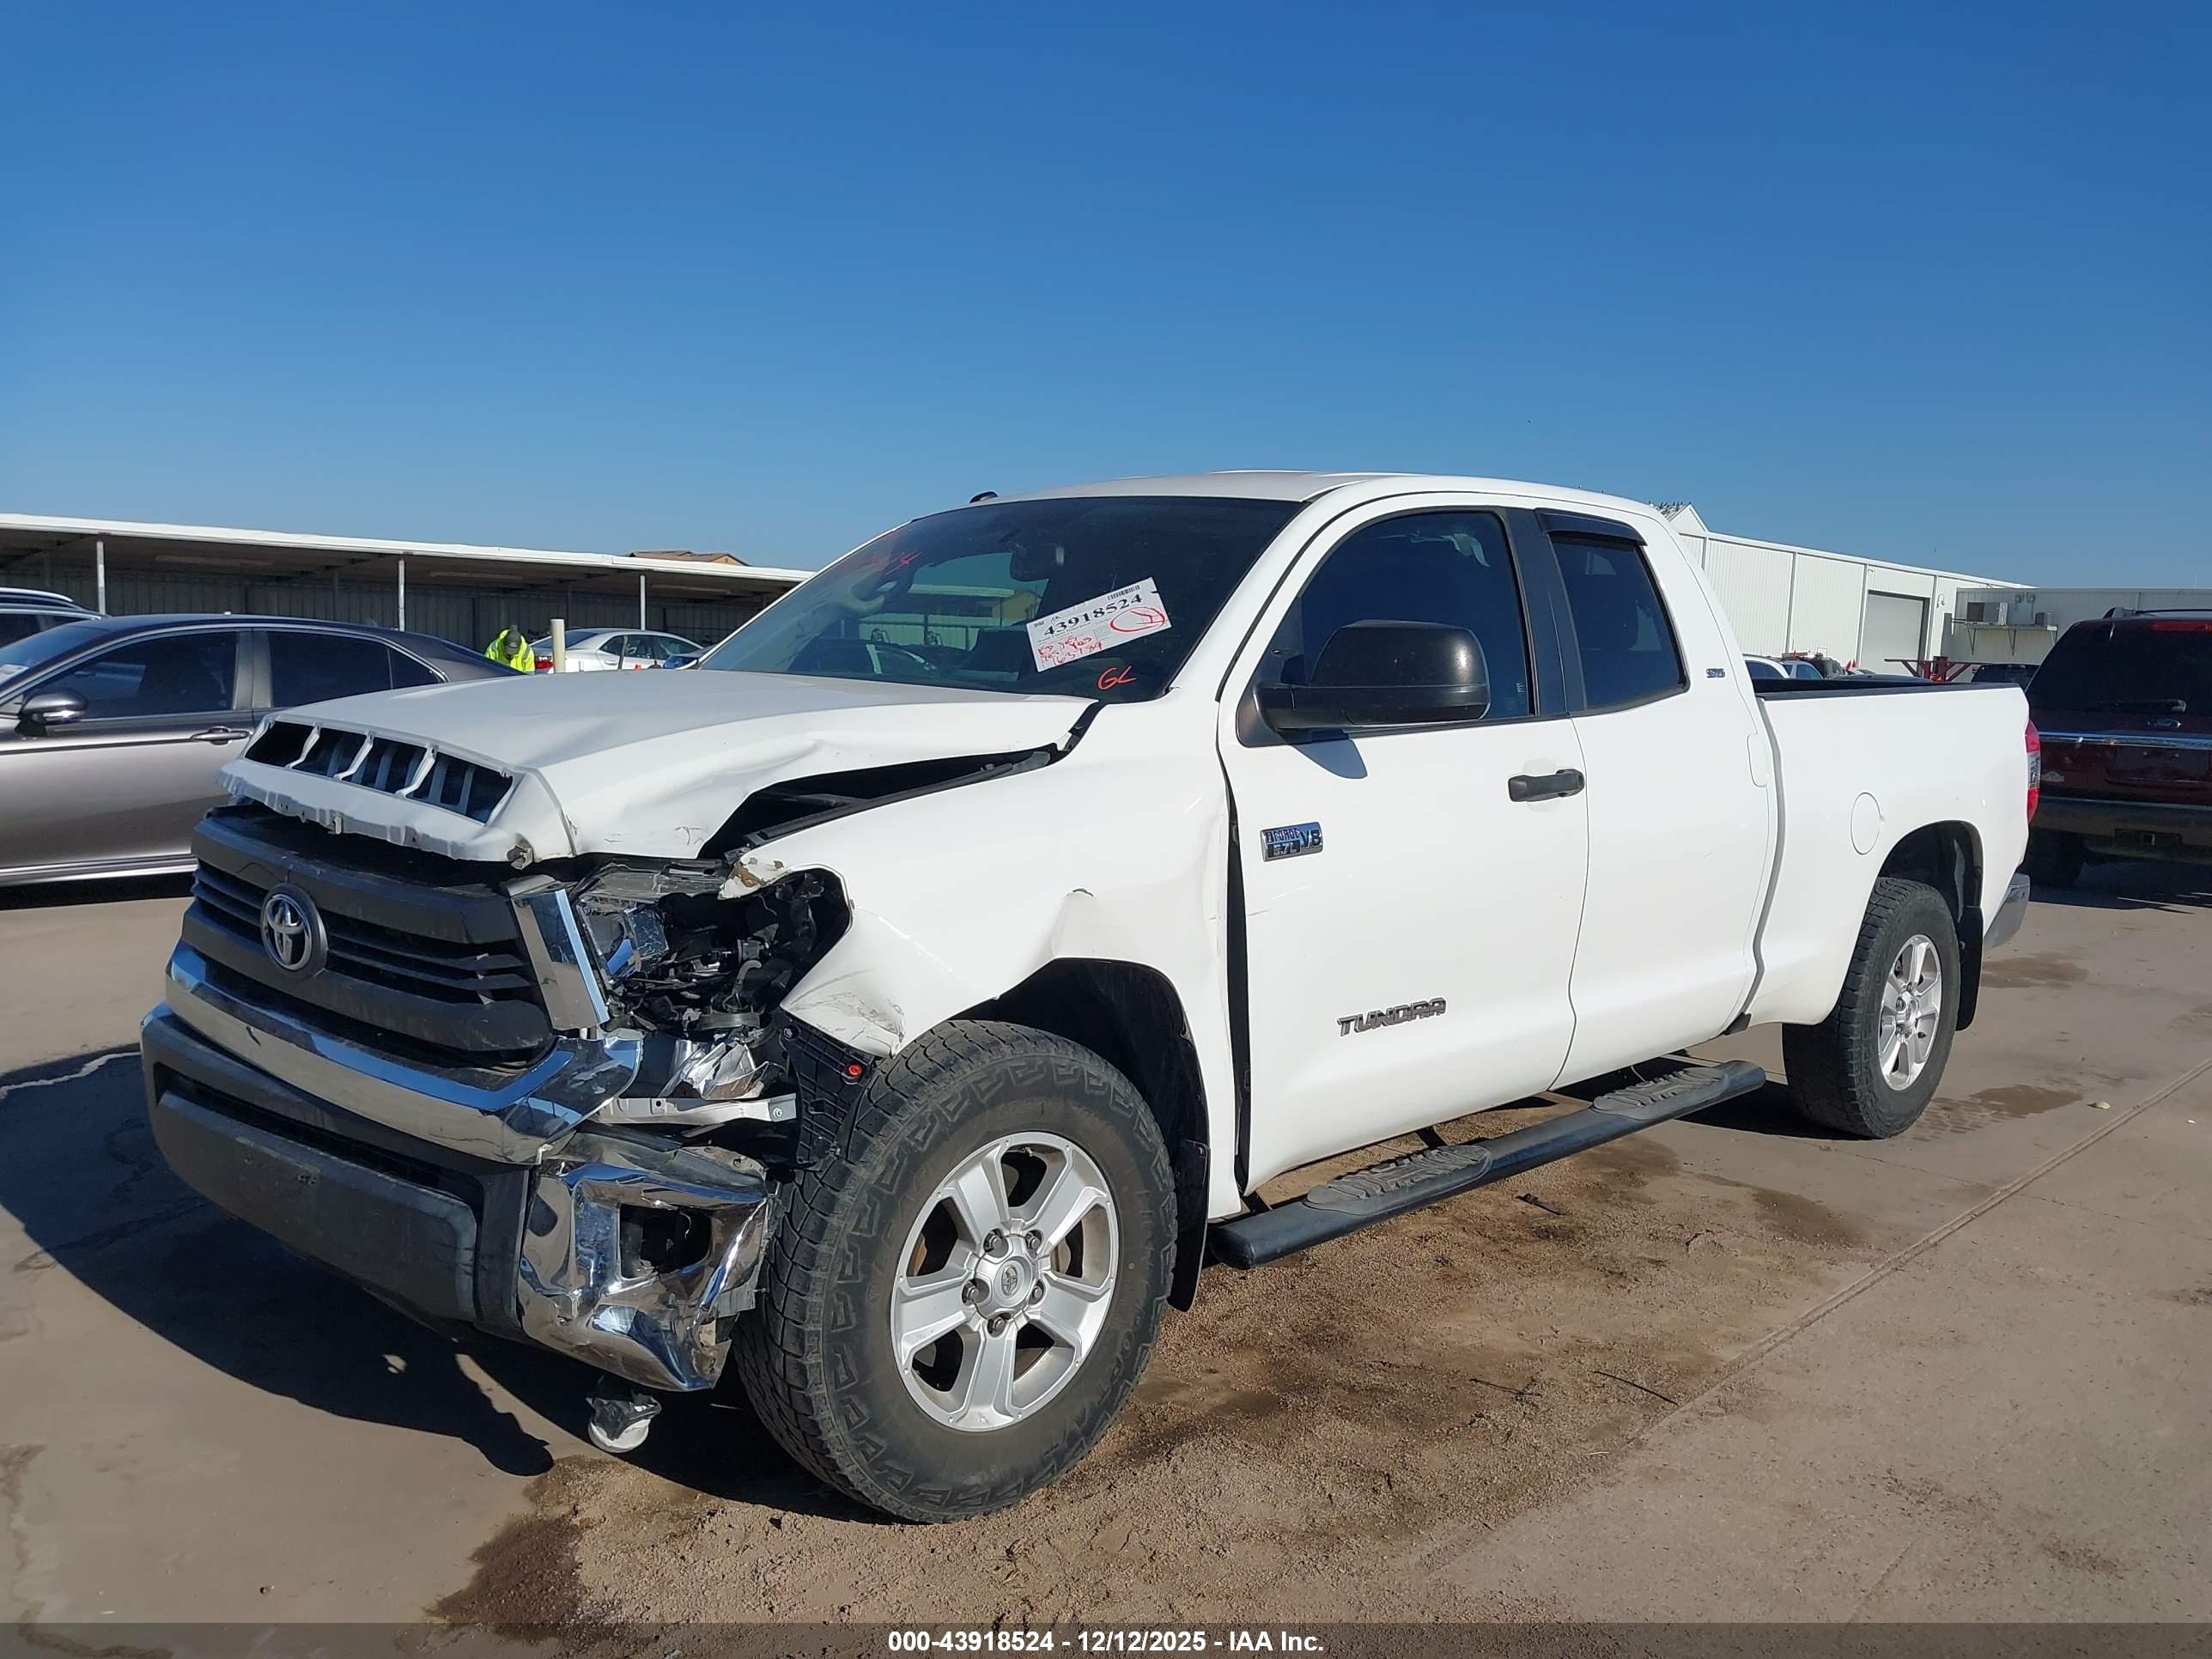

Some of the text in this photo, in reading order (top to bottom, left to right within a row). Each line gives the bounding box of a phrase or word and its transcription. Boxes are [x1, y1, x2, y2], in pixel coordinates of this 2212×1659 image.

[1043, 593, 1143, 636] 43918524
[1299, 829, 1322, 848] V8
[1337, 997, 1446, 1036] TUNDRA
